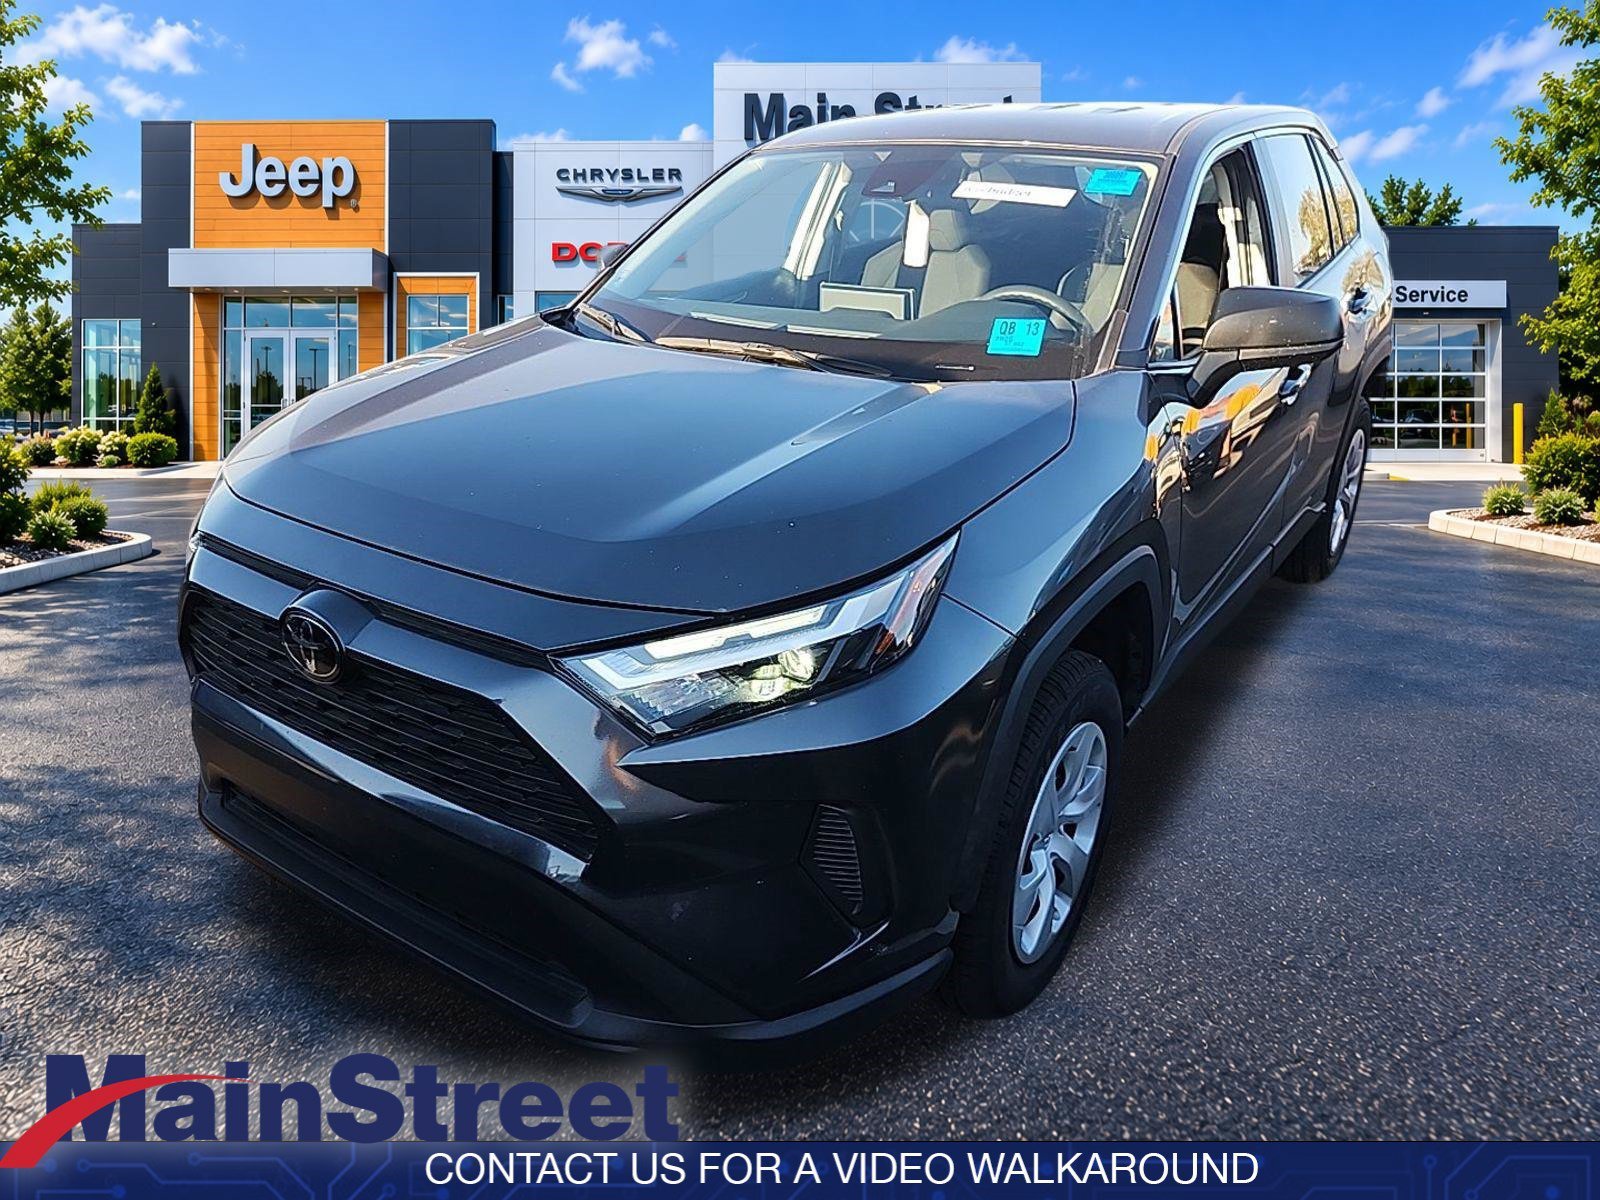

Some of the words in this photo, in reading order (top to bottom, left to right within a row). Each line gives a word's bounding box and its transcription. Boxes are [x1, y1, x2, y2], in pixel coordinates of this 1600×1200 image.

[218, 143, 355, 208] Jeep
[556, 168, 682, 182] CHRYSLER
[1395, 285, 1469, 303] Service
[1026, 322, 1040, 336] 13
